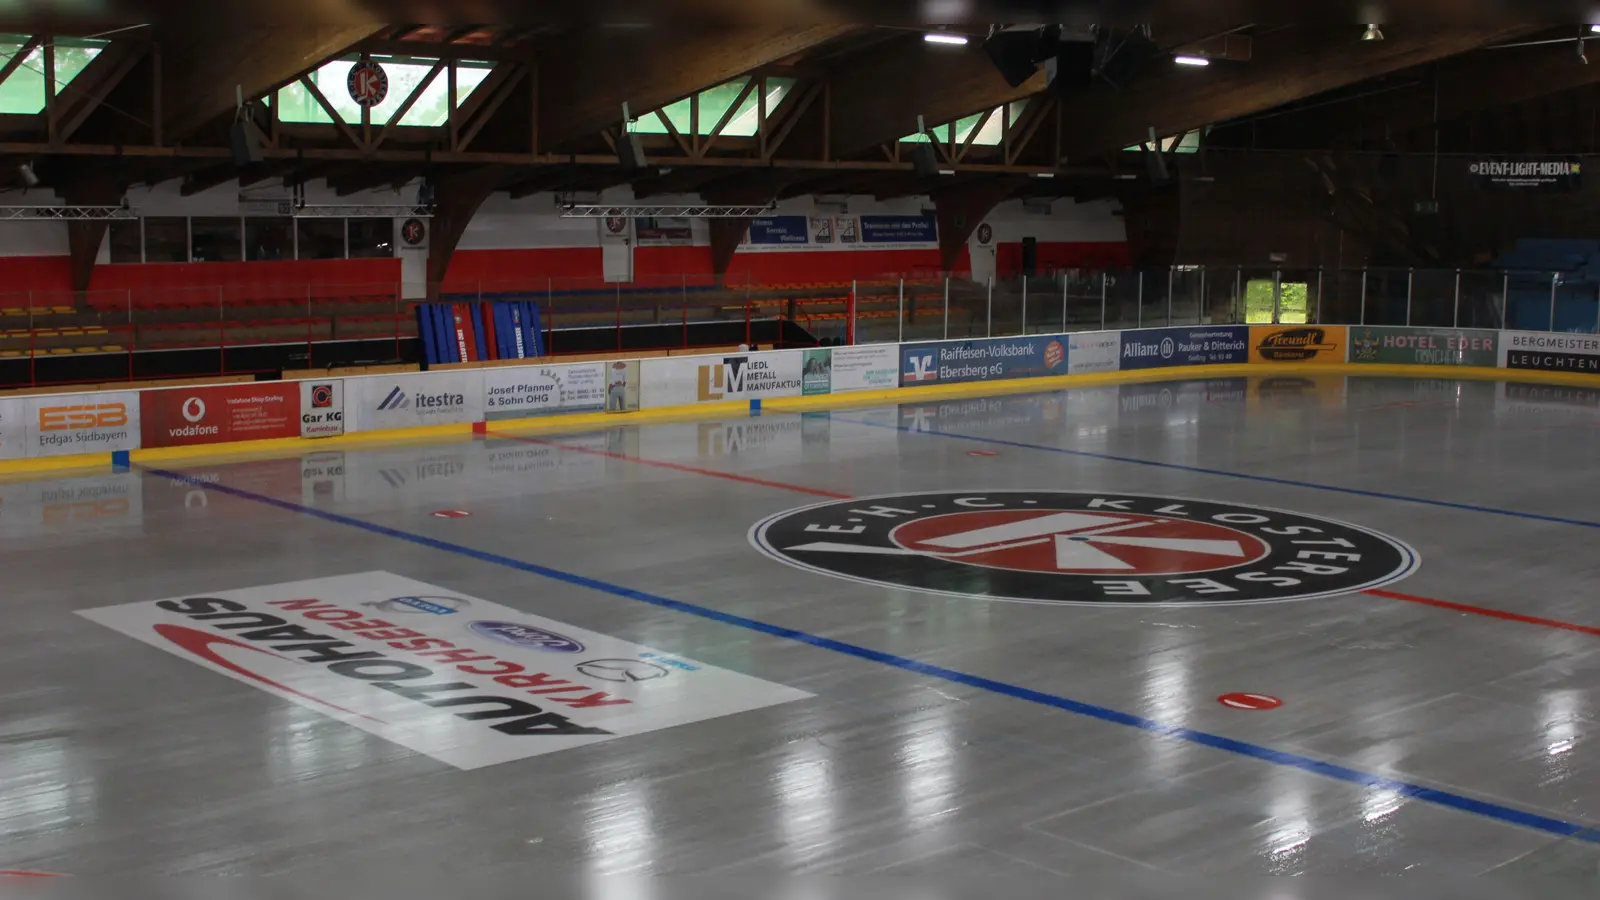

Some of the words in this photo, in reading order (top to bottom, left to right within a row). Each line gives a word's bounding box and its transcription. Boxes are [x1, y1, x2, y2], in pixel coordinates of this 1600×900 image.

[1479, 162, 1569, 175] EVENT-LIGHT-MEDIA
[1124, 342, 1159, 358] Allianz
[1178, 343, 1202, 353] Pauker
[1203, 341, 1209, 351] &
[1211, 340, 1245, 351] Ditterich
[1384, 335, 1437, 349] HOTEL
[1447, 336, 1493, 351] EDER
[1513, 336, 1599, 351] BERGMEISTER
[940, 343, 1034, 361] Raiffeisen-Volksbank
[747, 361, 768, 370] LIEDL
[1511, 354, 1598, 369] LEUCHTEN
[746, 371, 776, 381] METALL
[940, 364, 988, 379] Ebersberg
[989, 362, 1003, 376] eG
[487, 385, 515, 396] Josef
[518, 383, 554, 394] Pfanner
[746, 380, 801, 392] MANUFAKTUR
[416, 392, 464, 408] itestra
[487, 398, 495, 406] &
[498, 396, 523, 406] Sohn
[526, 394, 549, 404] OHG
[40, 403, 128, 432] ESB
[303, 414, 323, 424] Gar
[326, 411, 342, 422] KG
[169, 424, 219, 437] vodafone
[40, 434, 73, 447] Erdgas
[76, 430, 127, 444] Südbayern
[1087, 498, 1362, 596] KLOSTERSEE
[266, 598, 633, 708] KIRCHSEEON
[155, 597, 616, 735] AUTOHAUS
